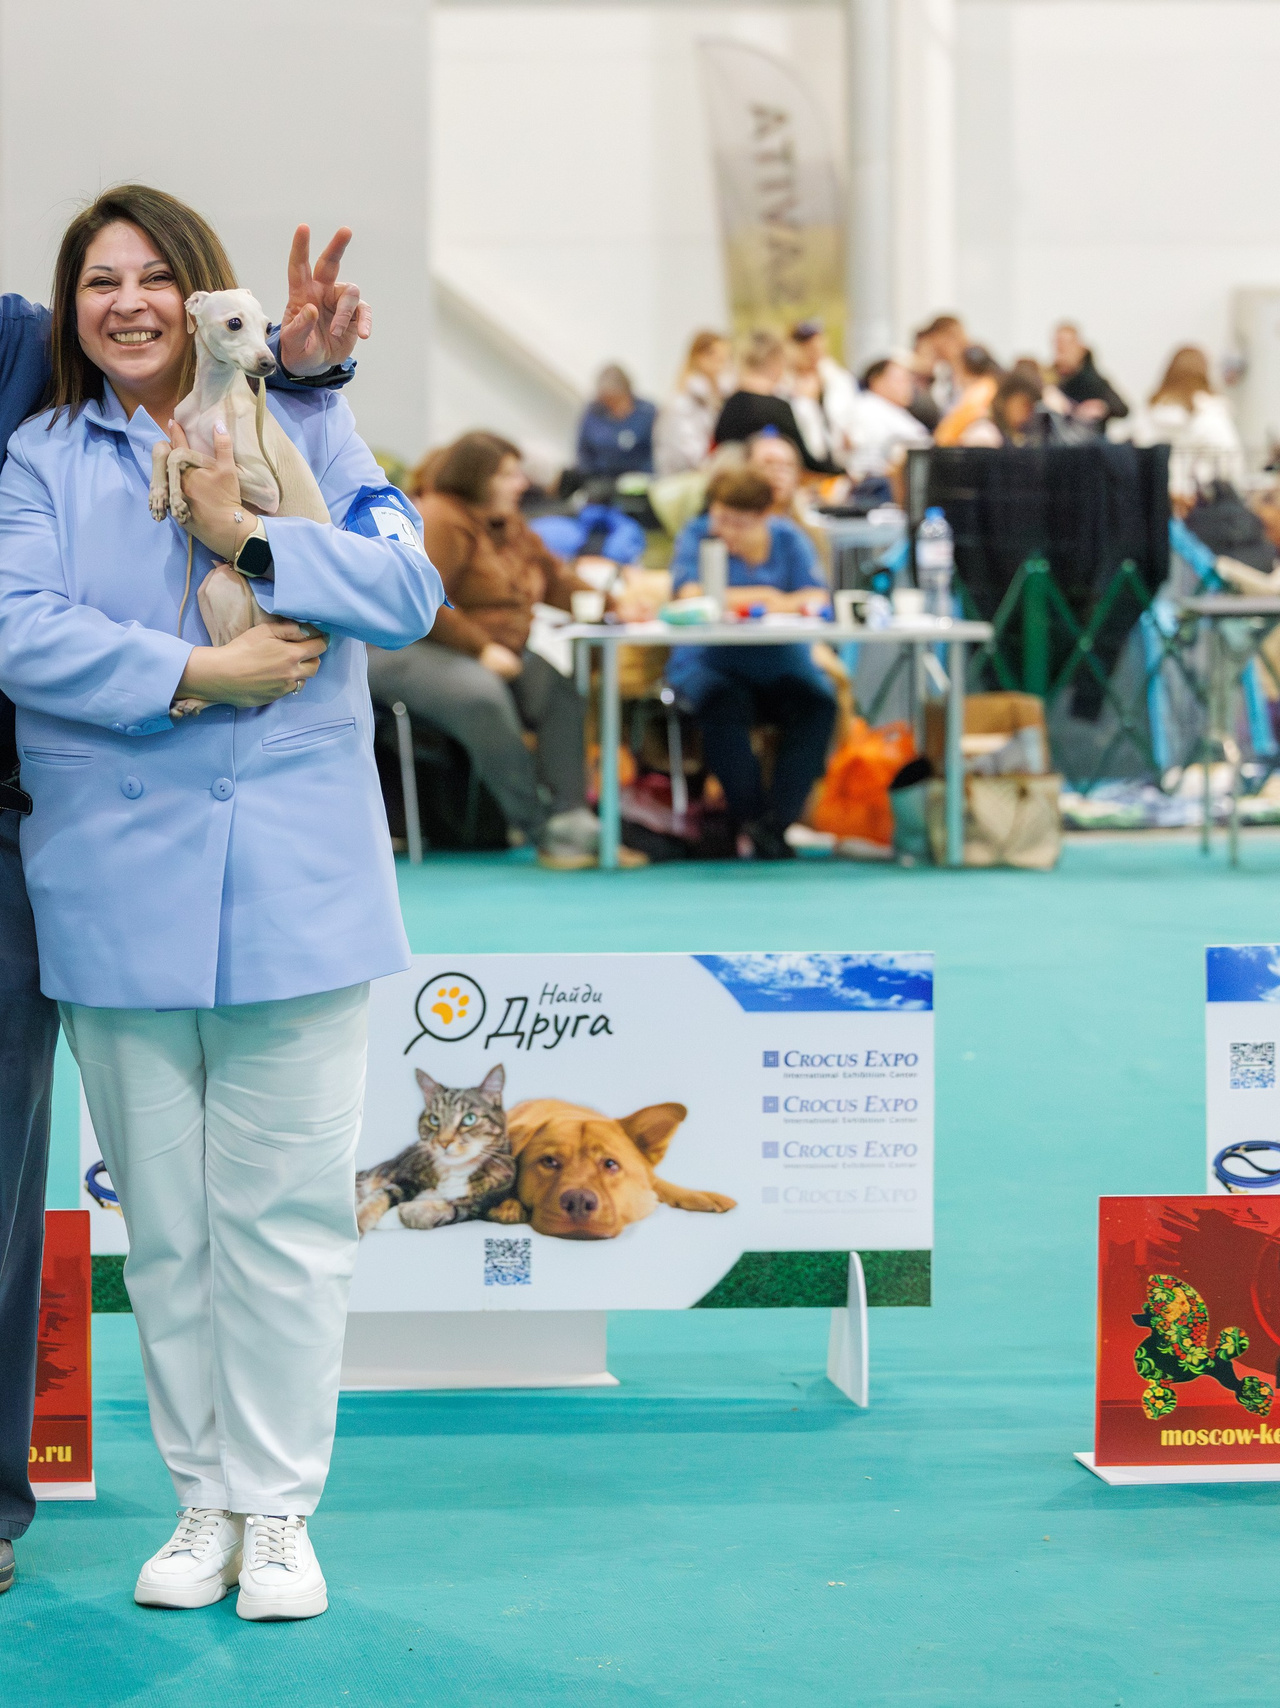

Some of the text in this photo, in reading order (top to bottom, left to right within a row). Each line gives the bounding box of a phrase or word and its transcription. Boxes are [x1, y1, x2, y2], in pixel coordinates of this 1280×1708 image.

[538, 982, 603, 1005] Найди
[483, 996, 614, 1050] Друга
[784, 1050, 919, 1068] CROCUS EXPO
[783, 1096, 918, 1113] CROCUS EXPO
